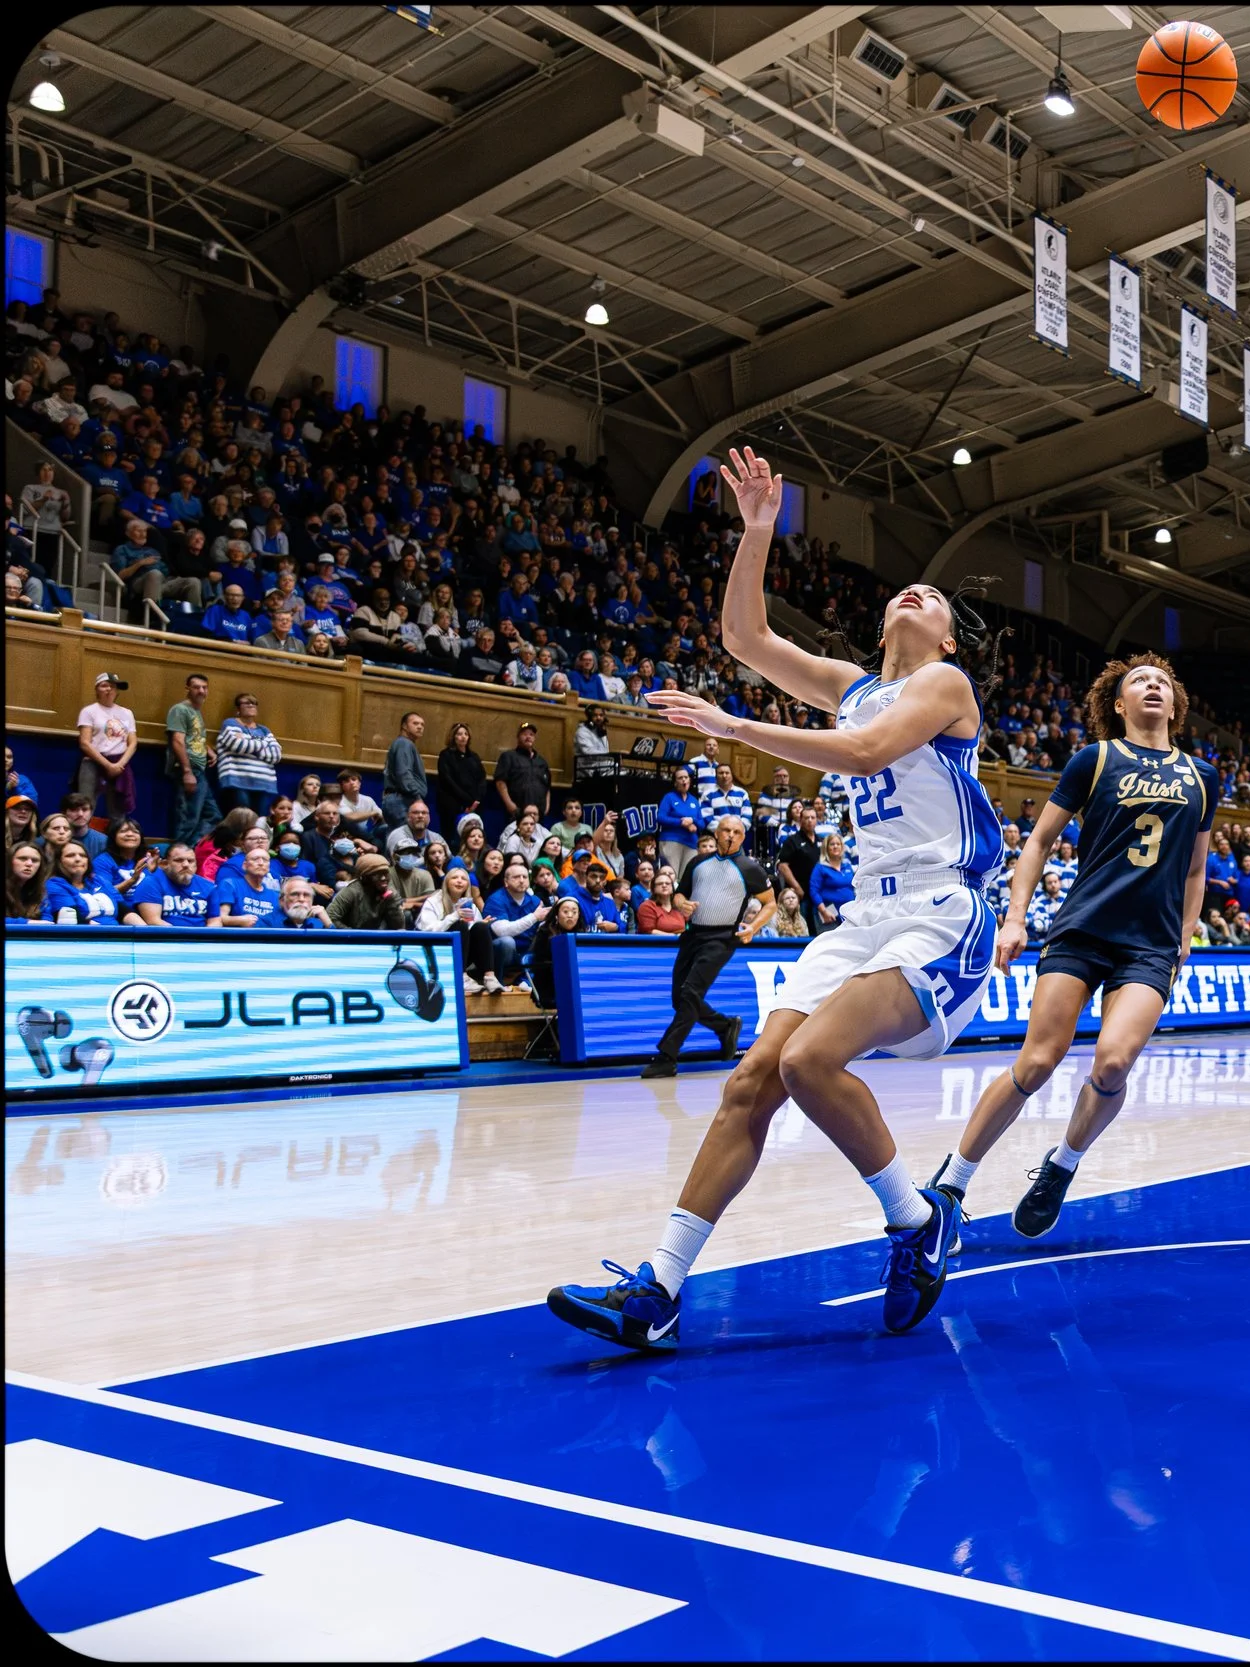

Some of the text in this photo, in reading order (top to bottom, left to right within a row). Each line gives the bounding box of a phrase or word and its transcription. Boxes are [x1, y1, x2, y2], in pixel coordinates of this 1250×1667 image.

[850, 766, 904, 828] 22
[1117, 772, 1189, 804] Irish
[623, 804, 658, 838] DU
[1127, 813, 1164, 868] 3
[163, 895, 208, 915] DUKE
[183, 989, 386, 1029] JLAB
[289, 1073, 333, 1082] DAKTRONICS
